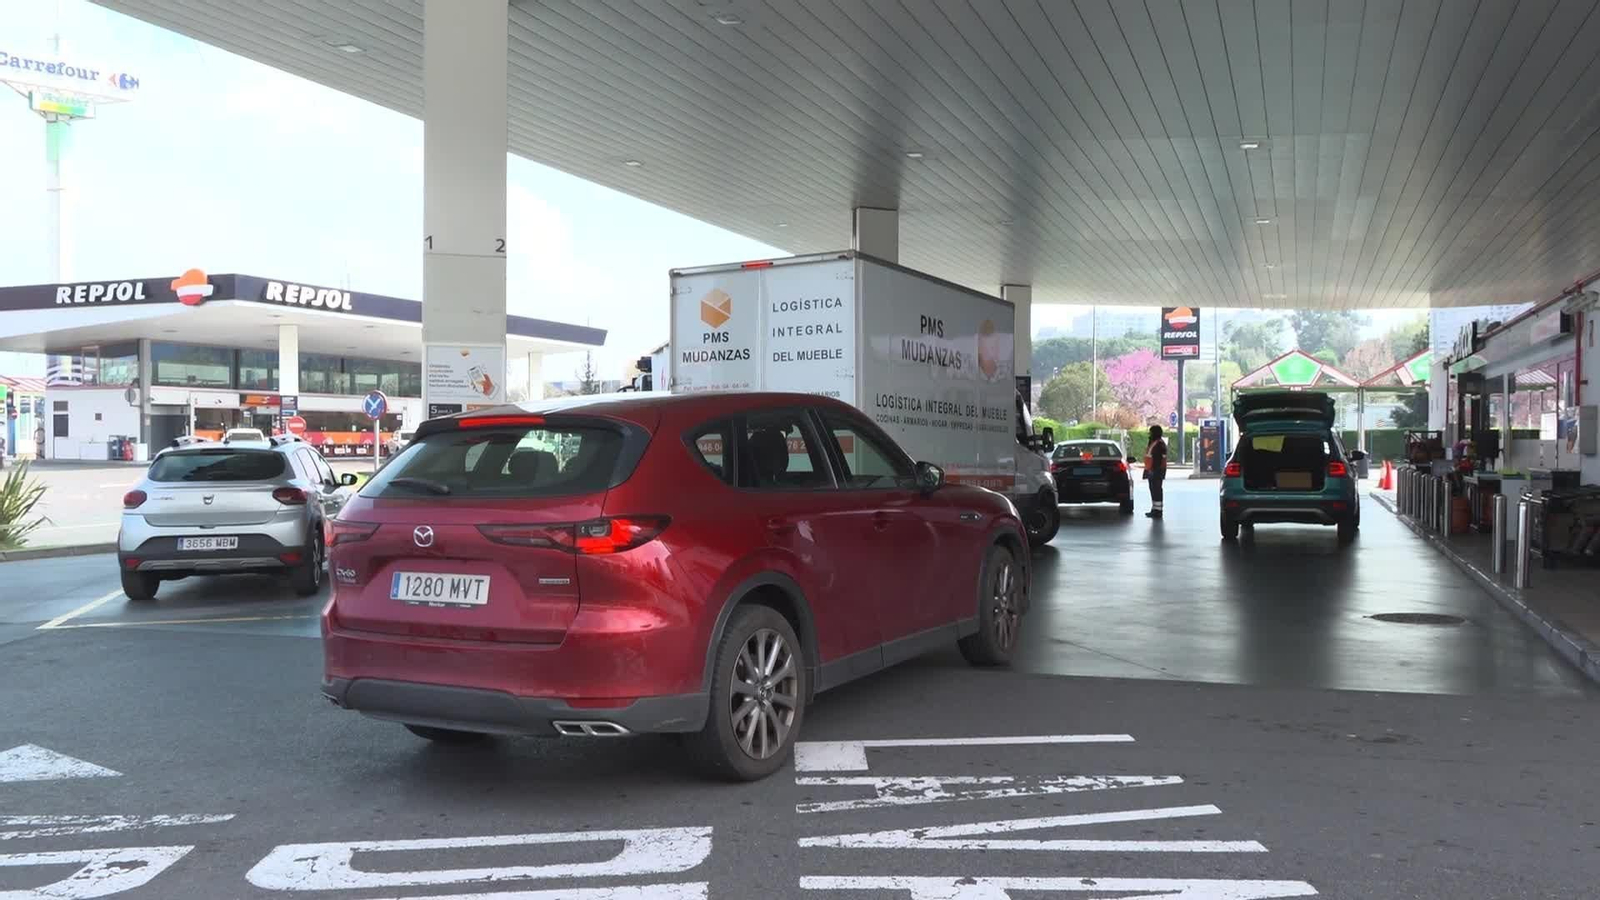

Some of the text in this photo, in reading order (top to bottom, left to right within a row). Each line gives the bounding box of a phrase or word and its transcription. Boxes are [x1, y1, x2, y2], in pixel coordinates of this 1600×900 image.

[0, 51, 100, 81] Carrefour
[424, 235, 433, 250] 1
[495, 238, 505, 253] 2
[56, 282, 146, 304] REPSOL
[265, 281, 353, 310] REPSOL
[772, 297, 843, 313] LOGÍSTICA
[772, 323, 843, 338] INTEGRAL
[920, 314, 944, 339] PMS
[703, 331, 730, 344] PMS
[1163, 331, 1197, 339] REPSOL
[682, 348, 751, 363] MUDANZAS
[772, 348, 843, 362] DEL MUEBLE
[901, 338, 962, 370] MUDANZAS
[875, 393, 1007, 421] LOGÍSTICA INTEGRAL DEL MUEBLE
[405, 575, 485, 600] 1280 MVT
